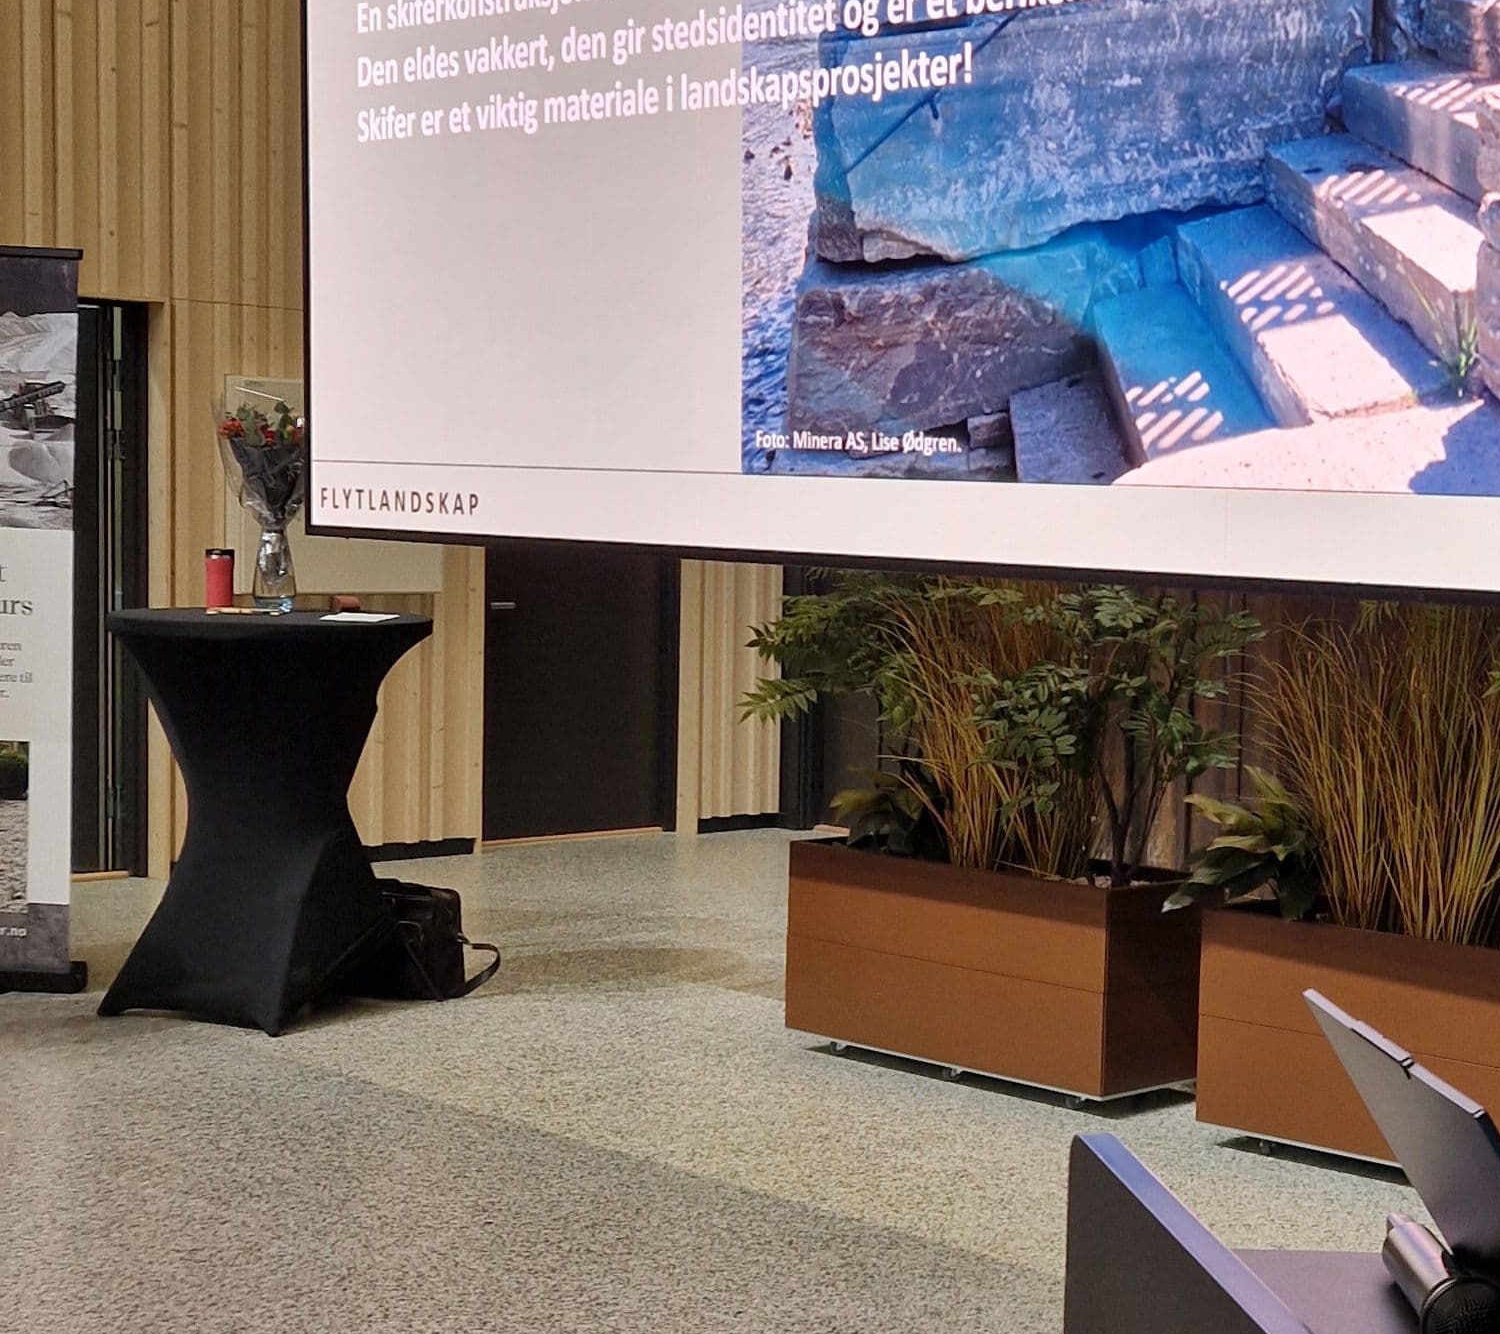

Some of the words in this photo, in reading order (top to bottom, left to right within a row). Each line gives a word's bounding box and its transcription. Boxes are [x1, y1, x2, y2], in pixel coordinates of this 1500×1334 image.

[356, 0, 383, 34] En
[356, 56, 399, 89] Den
[403, 44, 460, 84] eldes
[463, 31, 556, 74] vakkert,
[561, 26, 607, 65] den
[611, 18, 646, 66] gir
[357, 103, 416, 144] Skifer
[420, 110, 445, 138] er
[447, 100, 472, 134] et
[475, 91, 539, 136] viktig
[542, 76, 660, 126] materiale
[665, 74, 674, 114] i
[679, 40, 974, 112] landskapsprosjekter!
[755, 429, 791, 449] Foto:
[792, 430, 844, 451] Minera
[845, 431, 870, 454] AS,
[871, 431, 899, 452] Lise
[902, 429, 962, 457] Ødgren.
[320, 487, 480, 516] FLYTLANDSKAP
